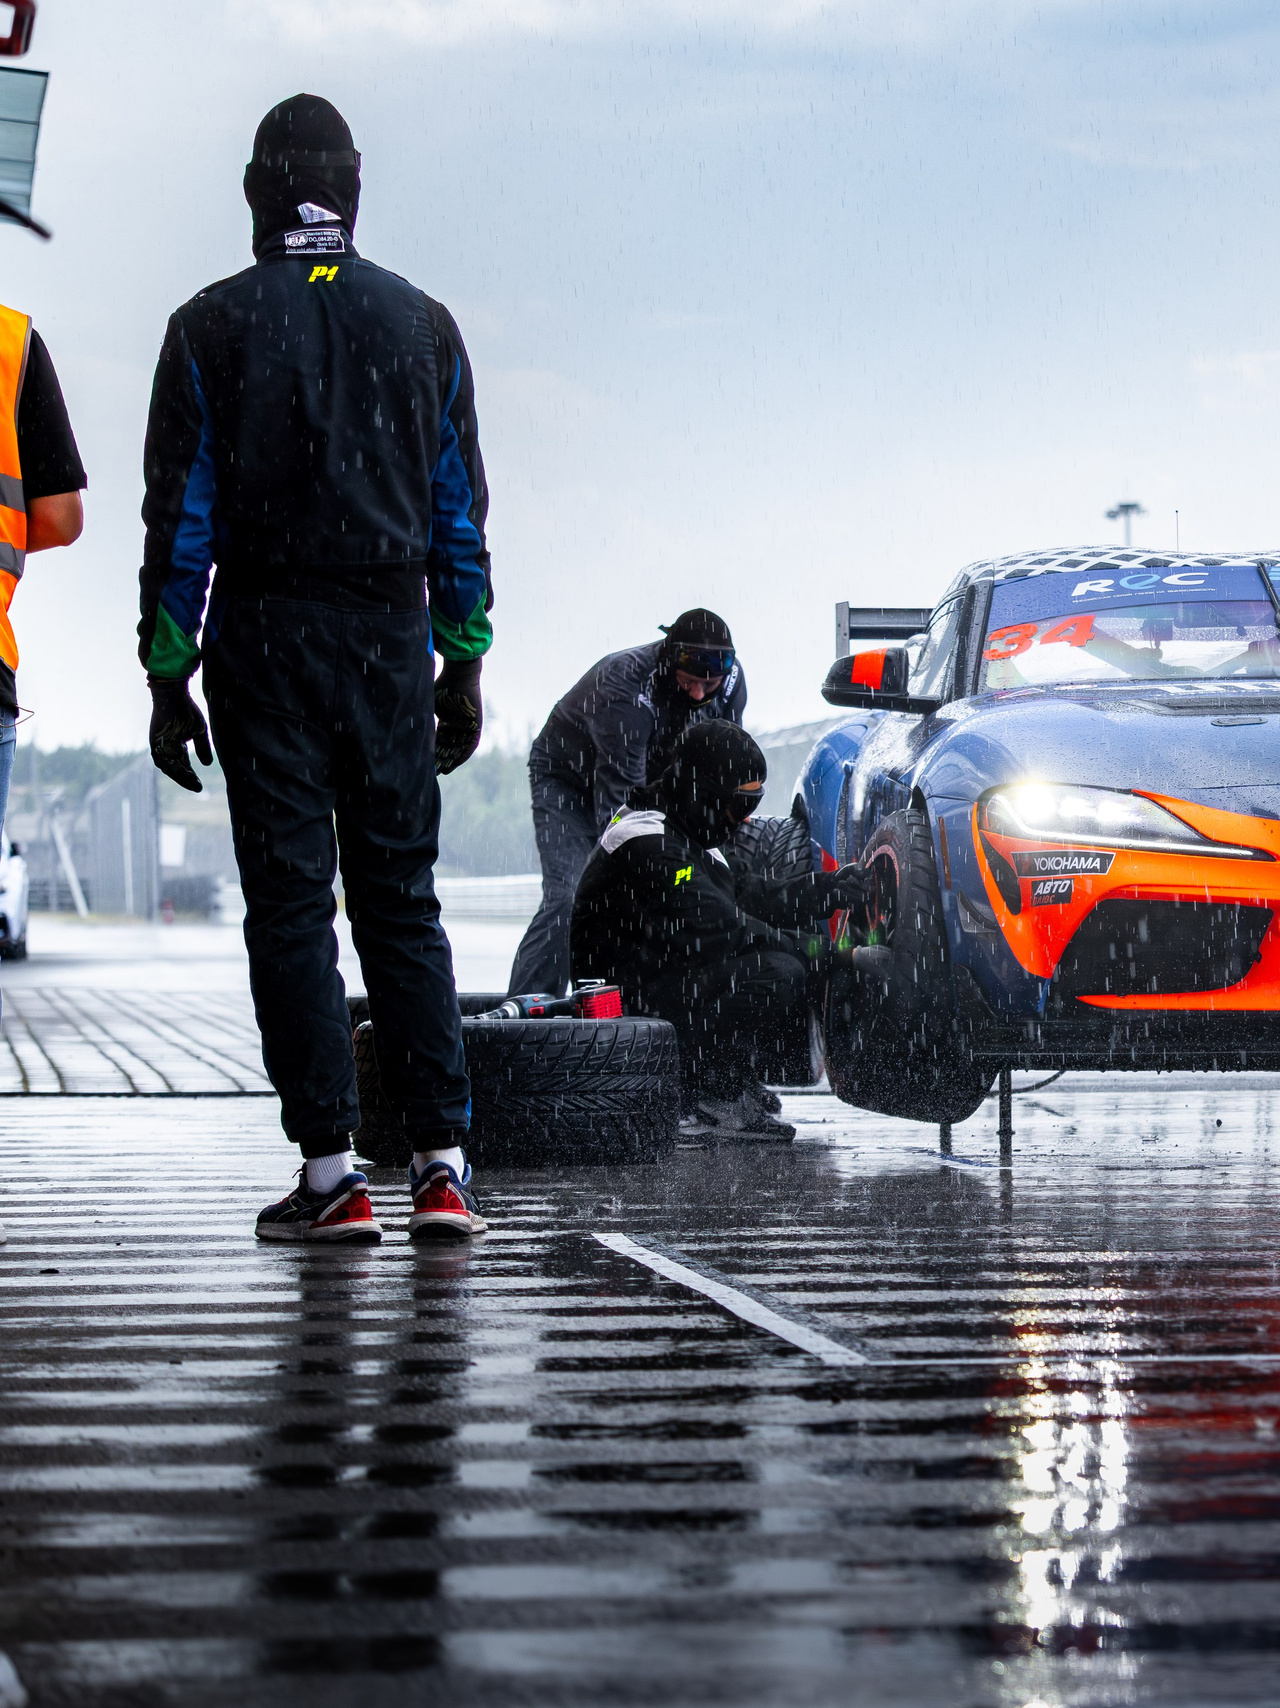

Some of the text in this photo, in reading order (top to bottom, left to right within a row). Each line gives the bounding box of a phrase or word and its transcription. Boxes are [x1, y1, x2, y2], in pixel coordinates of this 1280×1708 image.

[308, 266, 339, 282] P1
[983, 614, 1096, 661] 34
[1034, 856, 1100, 872] YOKOHAMA
[674, 865, 692, 885] P1
[1034, 879, 1070, 896] АВТО
